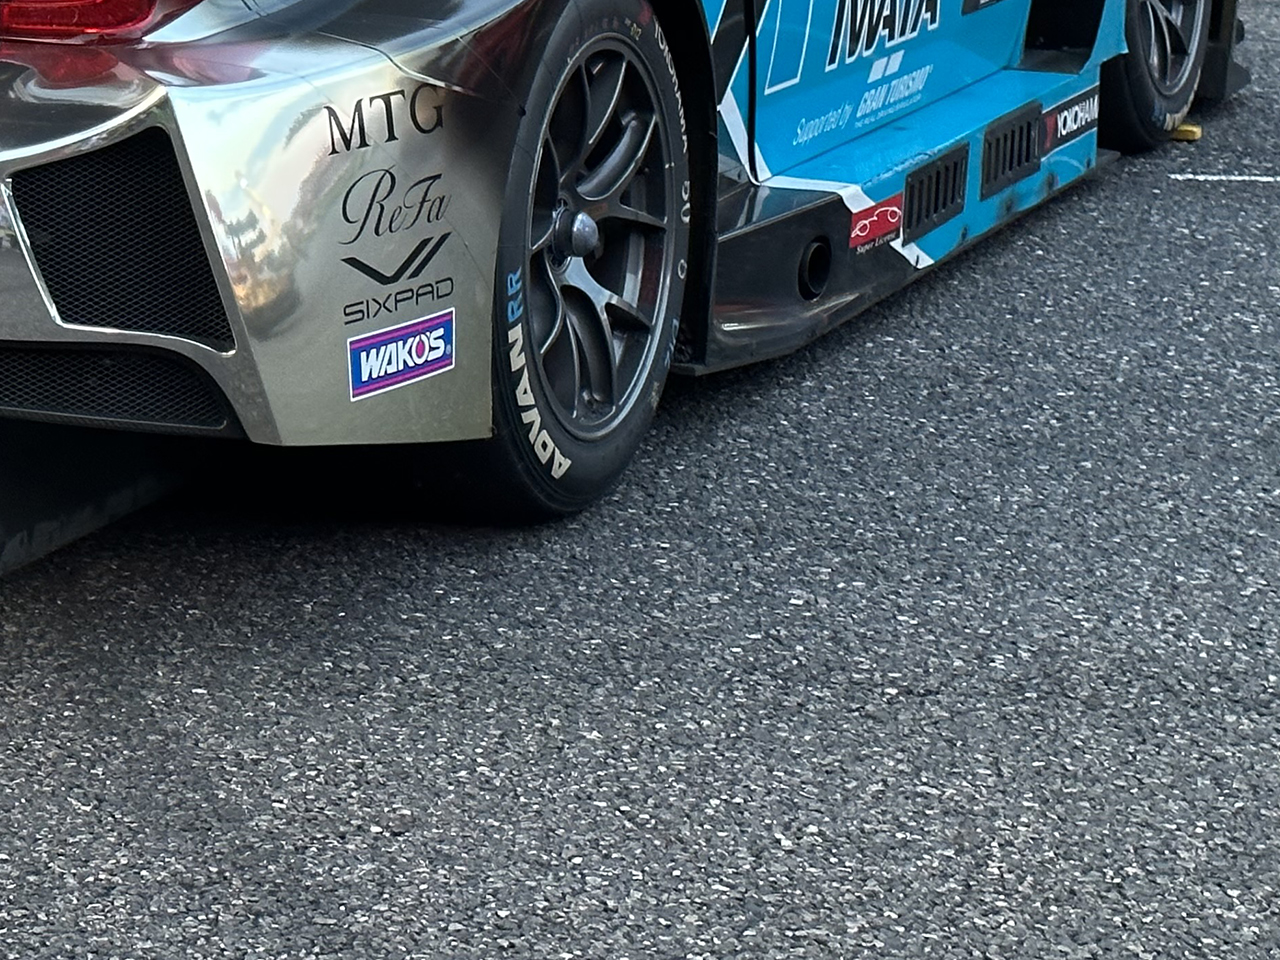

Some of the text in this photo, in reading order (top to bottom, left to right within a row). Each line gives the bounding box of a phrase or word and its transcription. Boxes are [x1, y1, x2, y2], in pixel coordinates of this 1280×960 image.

[856, 83, 889, 118] GRAN
[885, 64, 930, 106] TURISMO
[1056, 94, 1098, 139] YOKOHAM
[324, 83, 445, 157] MTG
[793, 103, 844, 147] Supported
[838, 100, 854, 130] by
[338, 164, 452, 246] ReFa
[343, 277, 455, 325] SIXPAD
[508, 323, 571, 481] ADVAN
